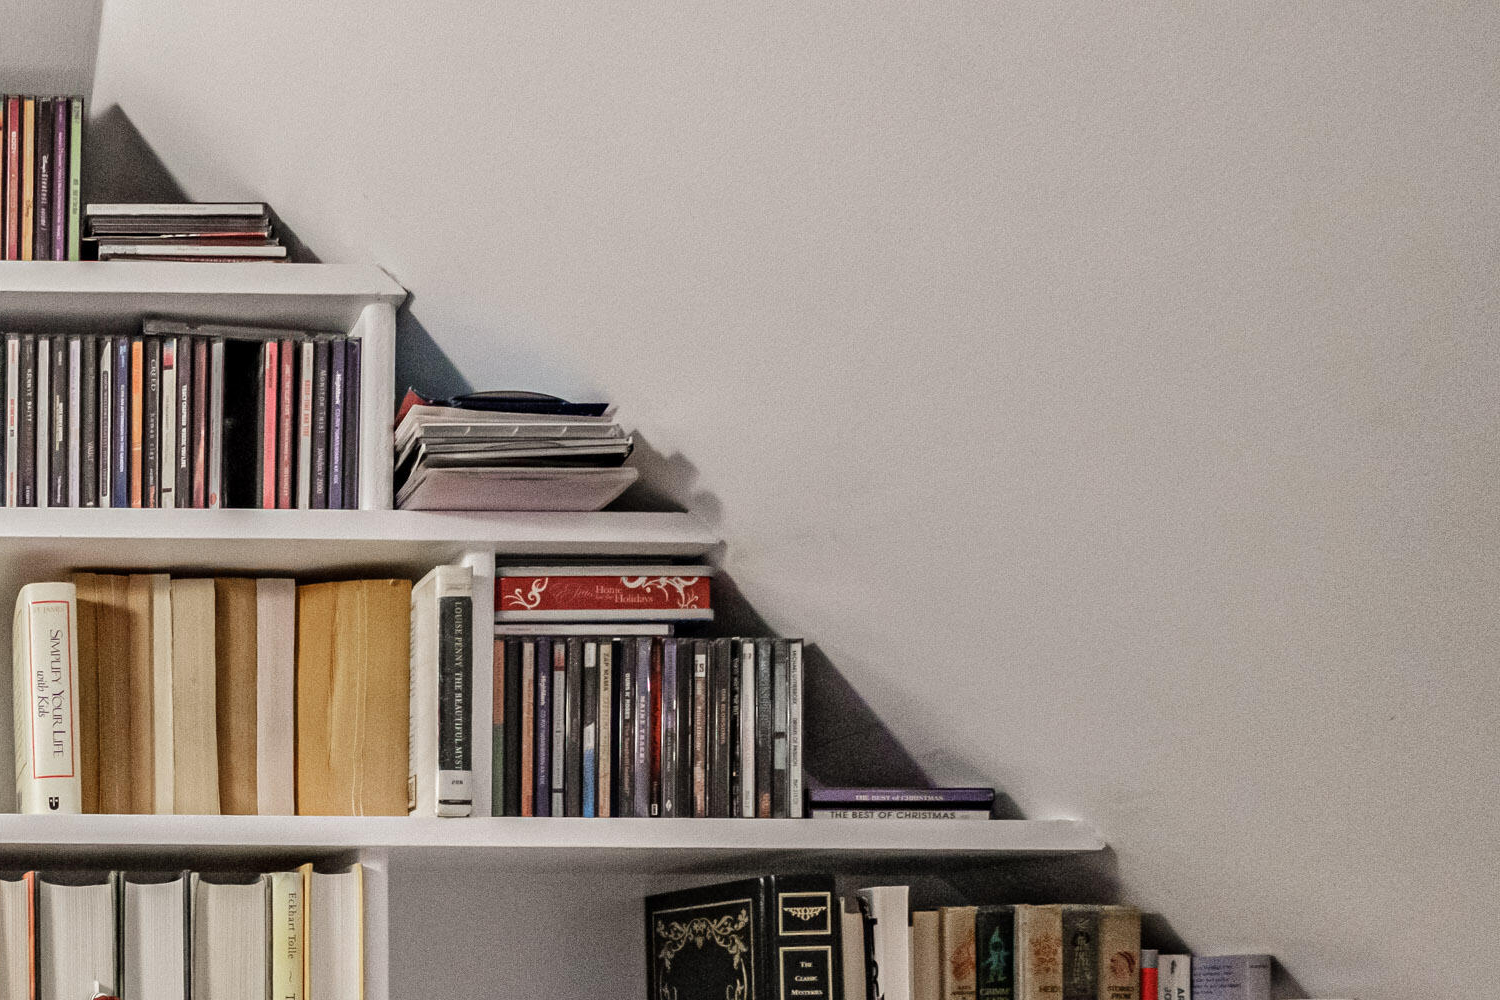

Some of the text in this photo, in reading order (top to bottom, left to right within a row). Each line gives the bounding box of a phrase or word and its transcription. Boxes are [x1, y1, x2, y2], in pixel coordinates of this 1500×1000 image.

[36, 671, 49, 718] with Kids
[48, 629, 65, 757] SIMPLIFY YOUR LIFE
[454, 602, 463, 771] LOUISE PENNY THE BEAUTIFUL MYST
[831, 811, 955, 819] THE BEST OF CHRISTMAS
[287, 892, 297, 959] Eckhart Tolle
